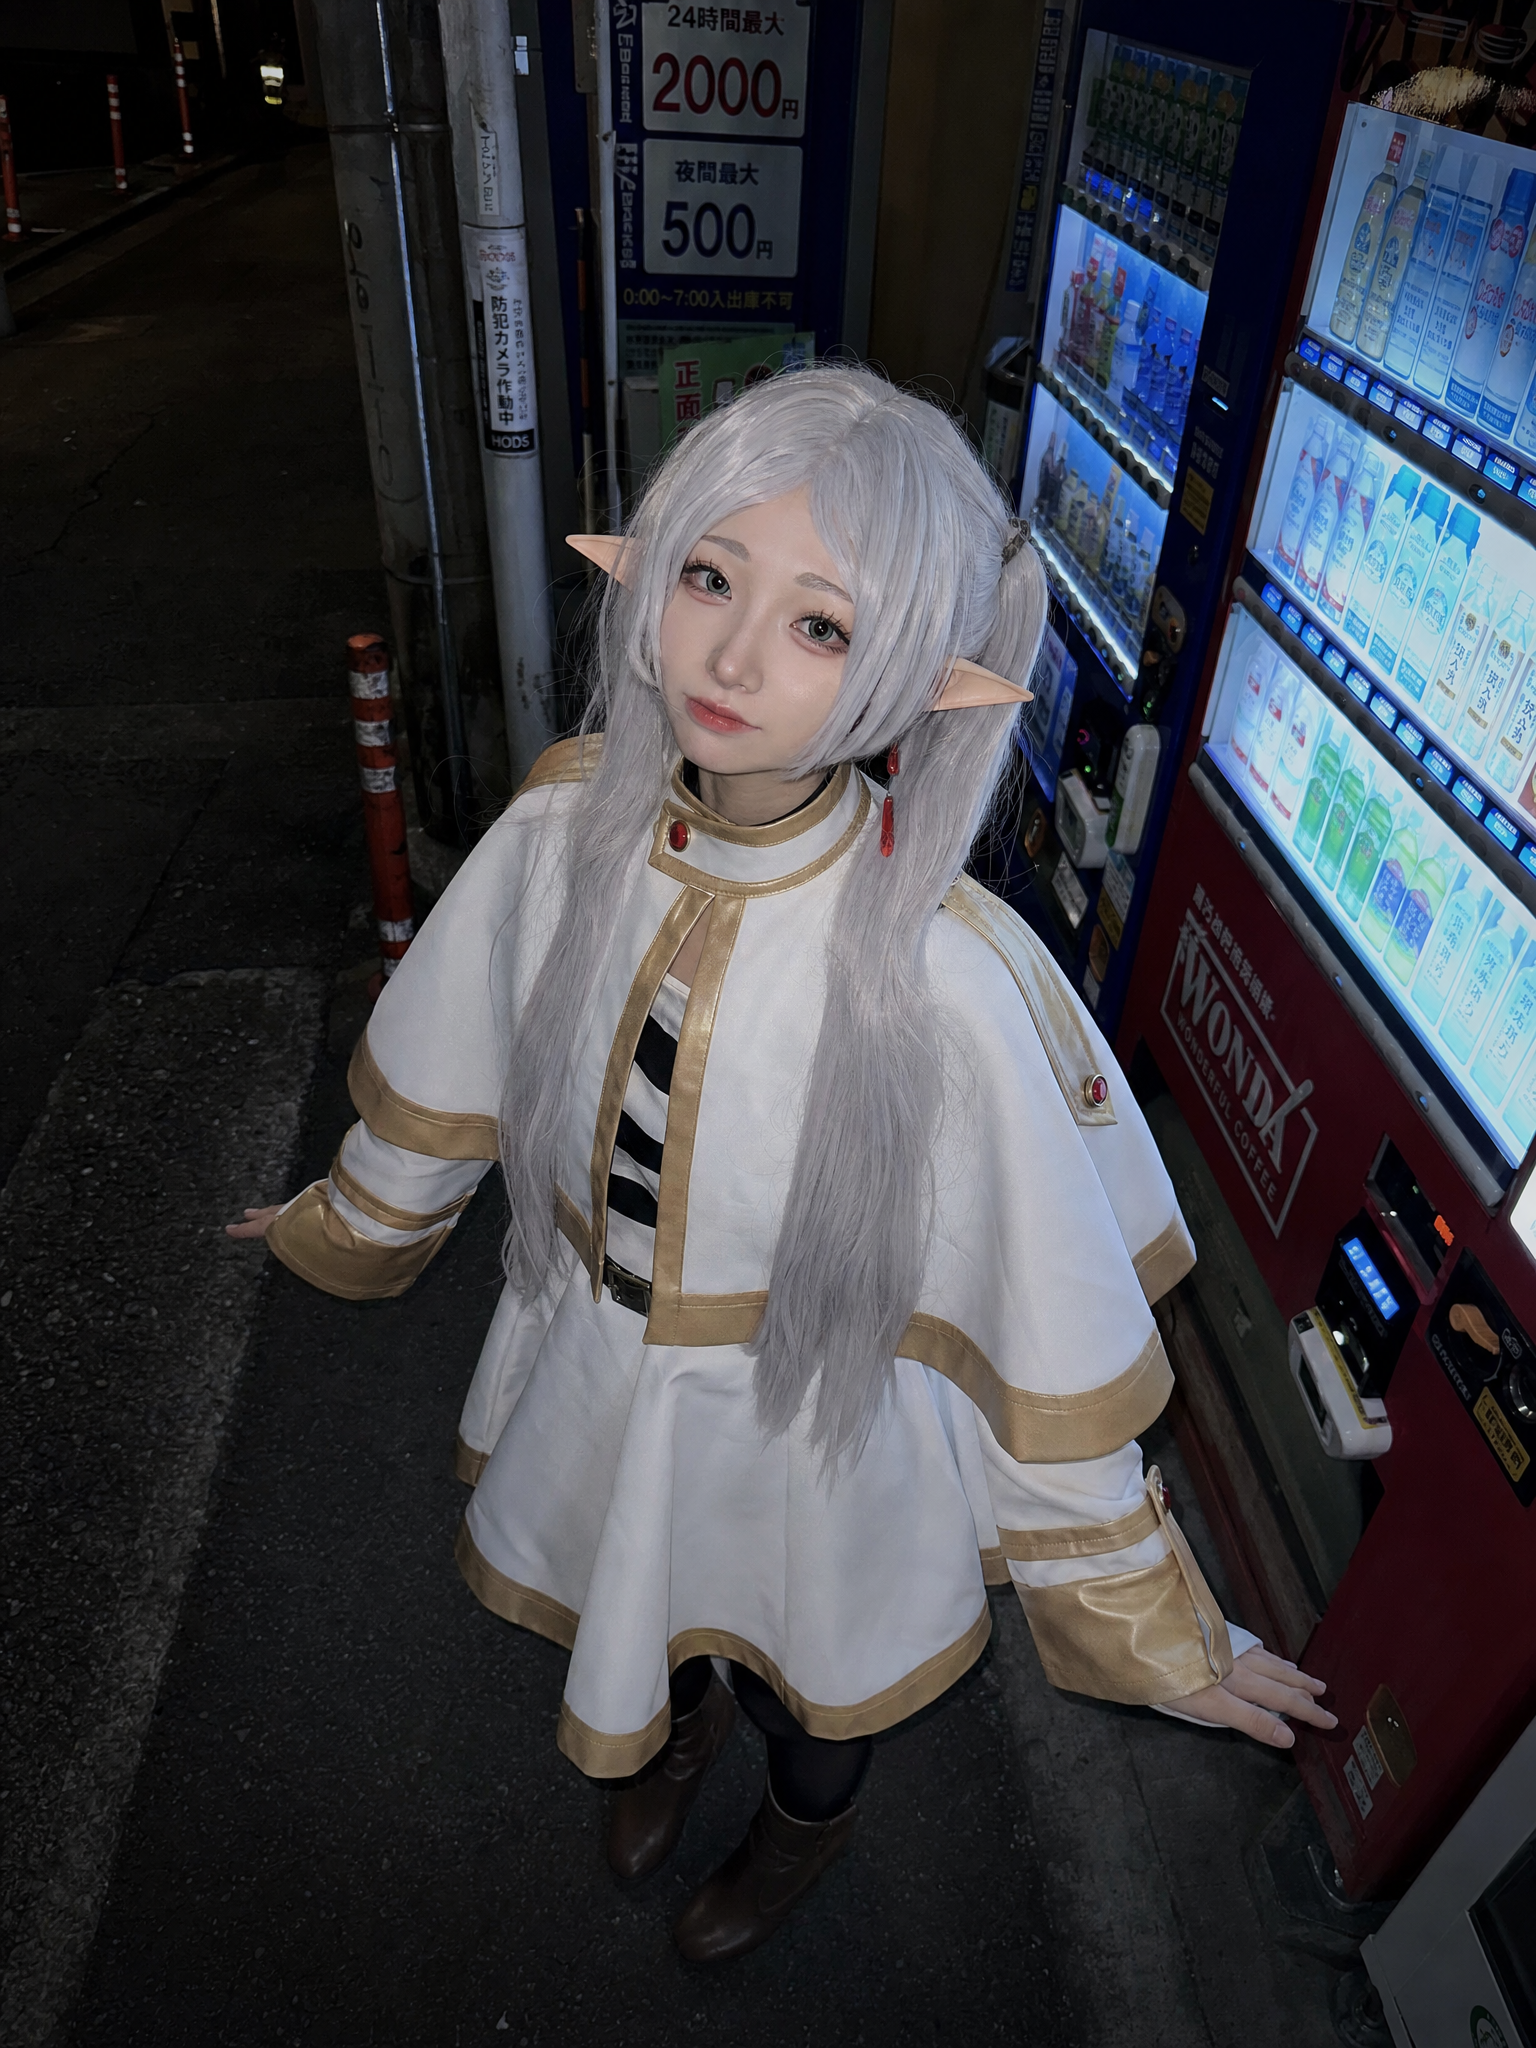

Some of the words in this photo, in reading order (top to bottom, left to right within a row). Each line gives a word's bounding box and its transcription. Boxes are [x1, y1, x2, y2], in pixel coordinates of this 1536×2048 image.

[667, 5, 785, 36] 24時間最大
[652, 52, 800, 120] 2000円
[674, 159, 760, 187] 夜間最大
[661, 200, 774, 260] 500円
[490, 295, 515, 426] 防犯カメラ作動中
[674, 360, 702, 437] 正面
[490, 433, 531, 450] HODS
[1180, 944, 1315, 1174] WONDA
[1176, 1009, 1232, 1120] WONDERFUL
[1233, 1119, 1279, 1203] COFFEE
